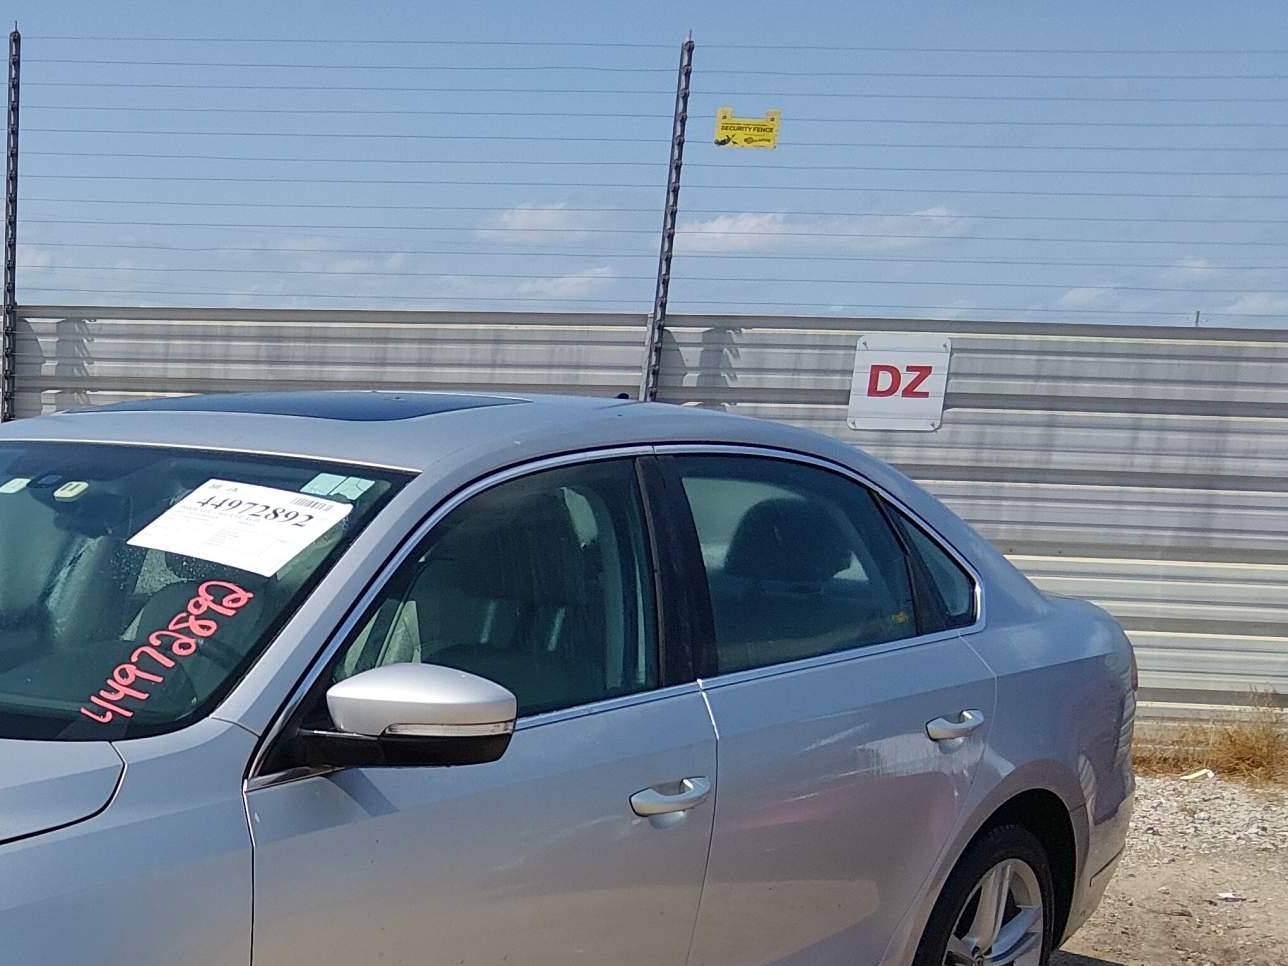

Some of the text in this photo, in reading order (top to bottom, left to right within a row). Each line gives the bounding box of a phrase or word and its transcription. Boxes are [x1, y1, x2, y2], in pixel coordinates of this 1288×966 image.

[721, 125, 752, 133] SECURITY
[867, 364, 933, 398] DZ
[196, 495, 315, 528] 44972892
[79, 580, 255, 724] 44972892
